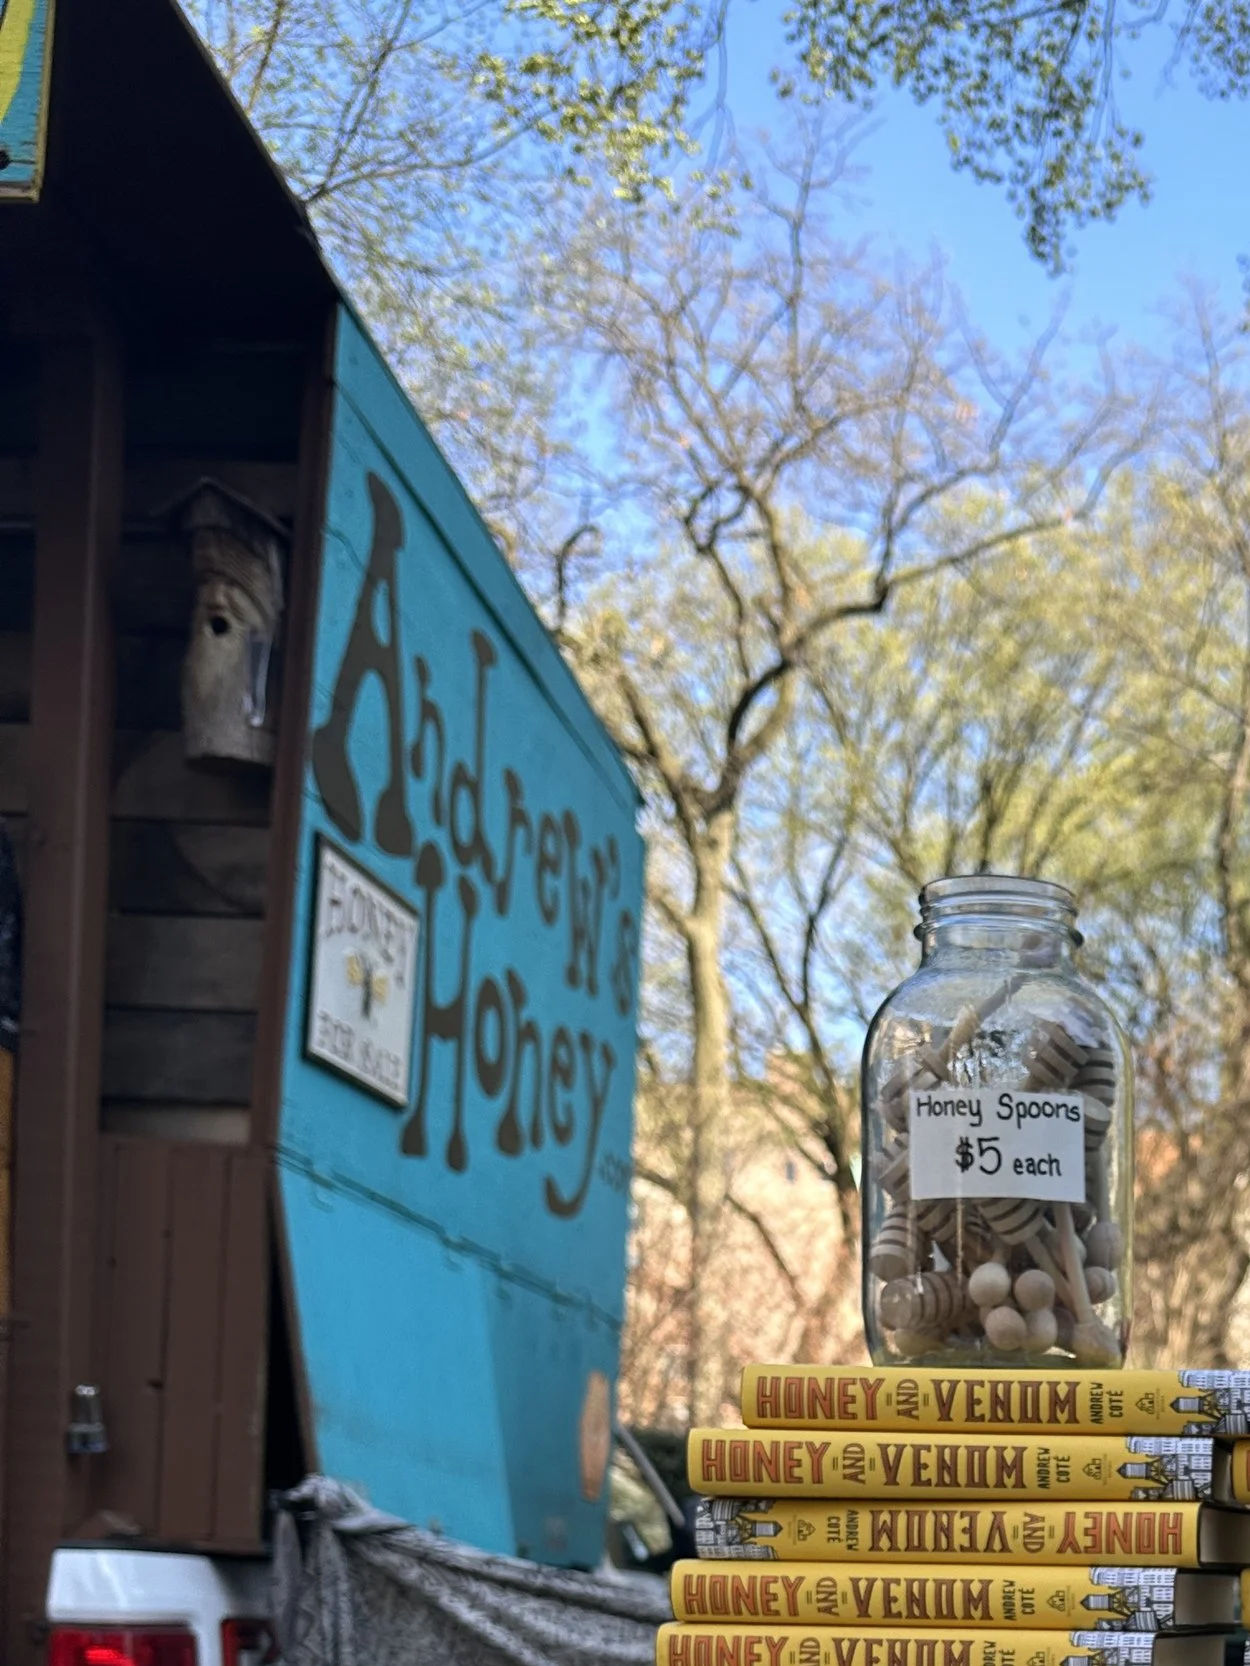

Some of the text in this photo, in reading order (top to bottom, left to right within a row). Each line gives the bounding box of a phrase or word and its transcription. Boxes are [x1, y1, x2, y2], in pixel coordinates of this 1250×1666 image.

[312, 472, 635, 1016] Andrew's
[401, 842, 616, 1218] Honey
[917, 1093, 1081, 1130] Honey Spoons
[955, 1136, 1062, 1177] $5 each
[756, 1377, 1080, 1424] HONEY AND VENOM
[1090, 1383, 1104, 1424] ANDREW
[1107, 1391, 1123, 1418] COTÉ
[702, 1440, 1028, 1488] HONEY AND VENOM
[1037, 1448, 1051, 1490] ANDREW
[1054, 1456, 1071, 1483] COTÉ
[827, 1516, 843, 1543] COTÉ
[846, 1511, 859, 1551] ANDREW
[869, 1510, 1182, 1554] HONEY AND VENOM
[684, 1575, 994, 1620] HONEY AND VENOM
[1002, 1580, 1018, 1622] ANDREW
[1020, 1589, 1035, 1615] COTÉ
